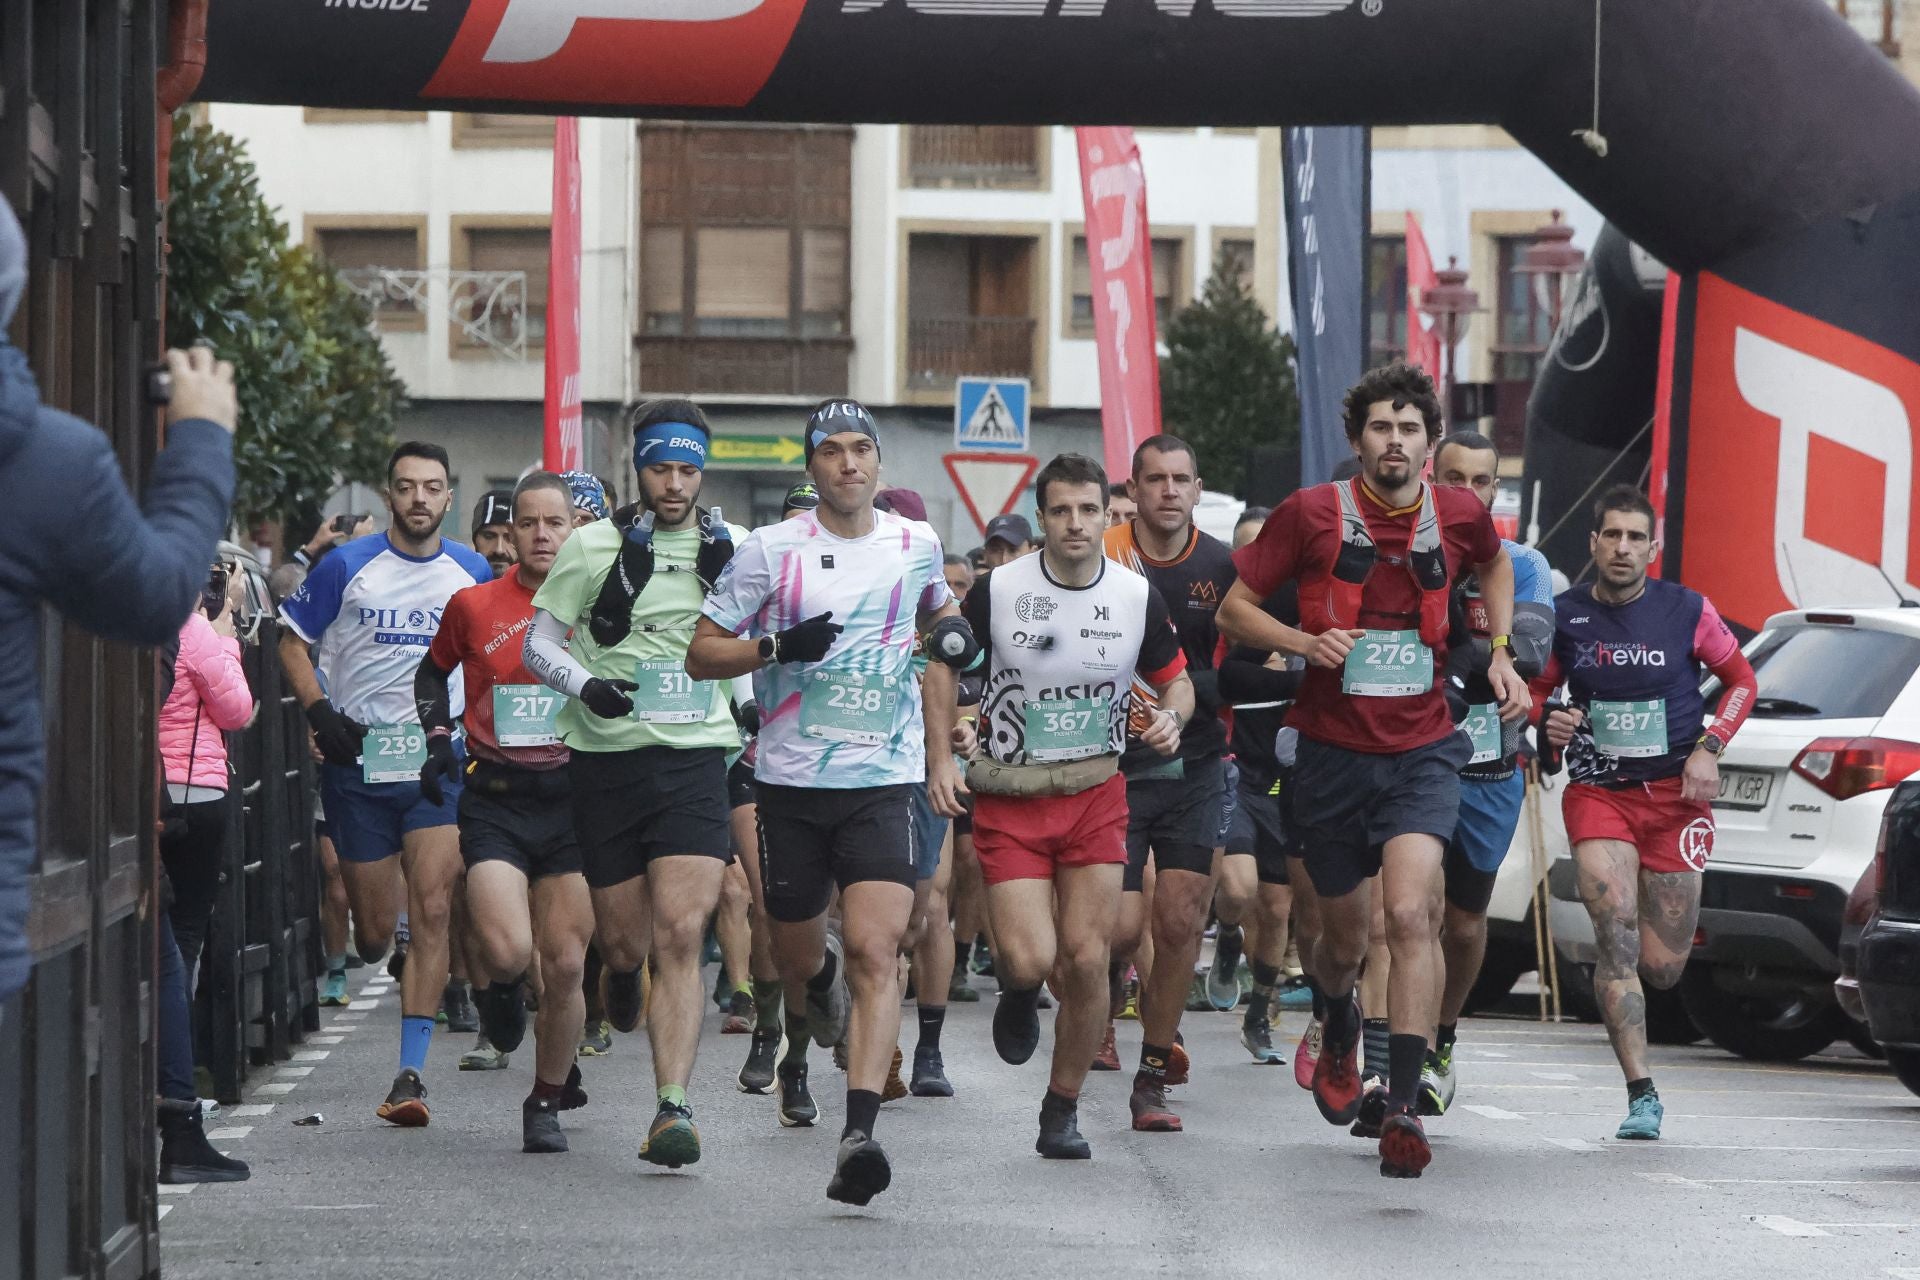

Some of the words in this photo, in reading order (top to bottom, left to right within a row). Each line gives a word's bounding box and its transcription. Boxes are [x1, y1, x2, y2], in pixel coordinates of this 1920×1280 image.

[484, 632, 509, 656] RECTA
[508, 616, 533, 637] FINAL
[1090, 629, 1122, 639] Nutergia
[1365, 643, 1416, 665] 276
[1598, 641, 1666, 666] hevia
[658, 672, 693, 693] 311
[512, 696, 553, 717] 217
[827, 684, 881, 712] 238
[1043, 710, 1092, 732] 367
[1605, 712, 1650, 731] 287
[377, 735, 421, 756] 239
[1734, 775, 1764, 801] KGR
